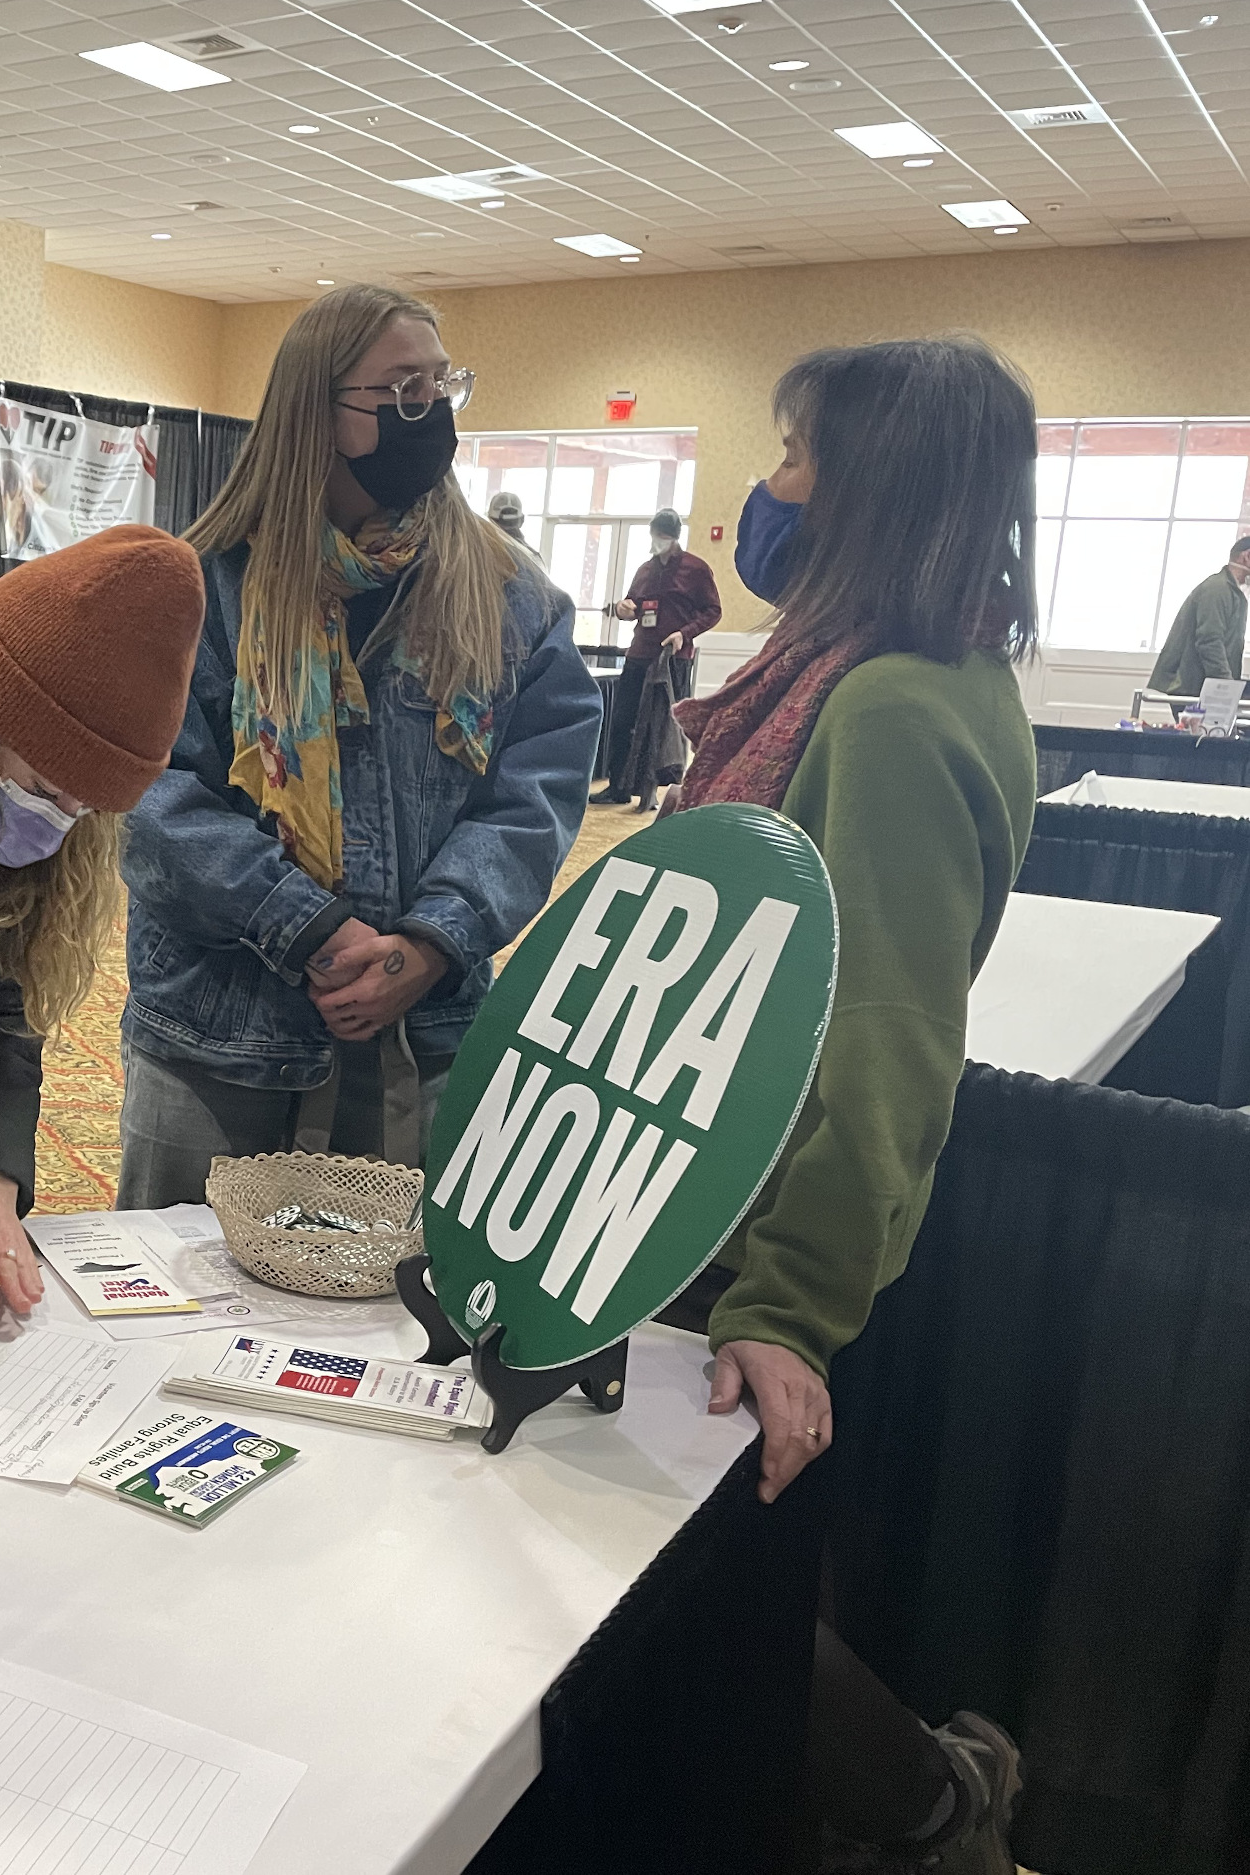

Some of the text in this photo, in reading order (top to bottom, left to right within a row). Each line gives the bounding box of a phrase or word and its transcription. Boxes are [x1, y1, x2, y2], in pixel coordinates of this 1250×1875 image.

[23, 410, 76, 452] TIP
[517, 856, 801, 1131] ERA
[430, 1047, 698, 1326] NOW
[102, 1284, 161, 1293] Popular
[104, 1289, 170, 1301] National
[454, 1376, 467, 1387] The
[448, 1387, 464, 1402] Equal
[173, 1415, 213, 1438] Equal
[88, 1413, 185, 1466] Strong Families
[133, 1435, 179, 1459] Rights
[98, 1458, 139, 1481] Build
[212, 1464, 247, 1485] WOMEN
[235, 1469, 257, 1481] 4.2
[200, 1478, 243, 1503] MILLION
